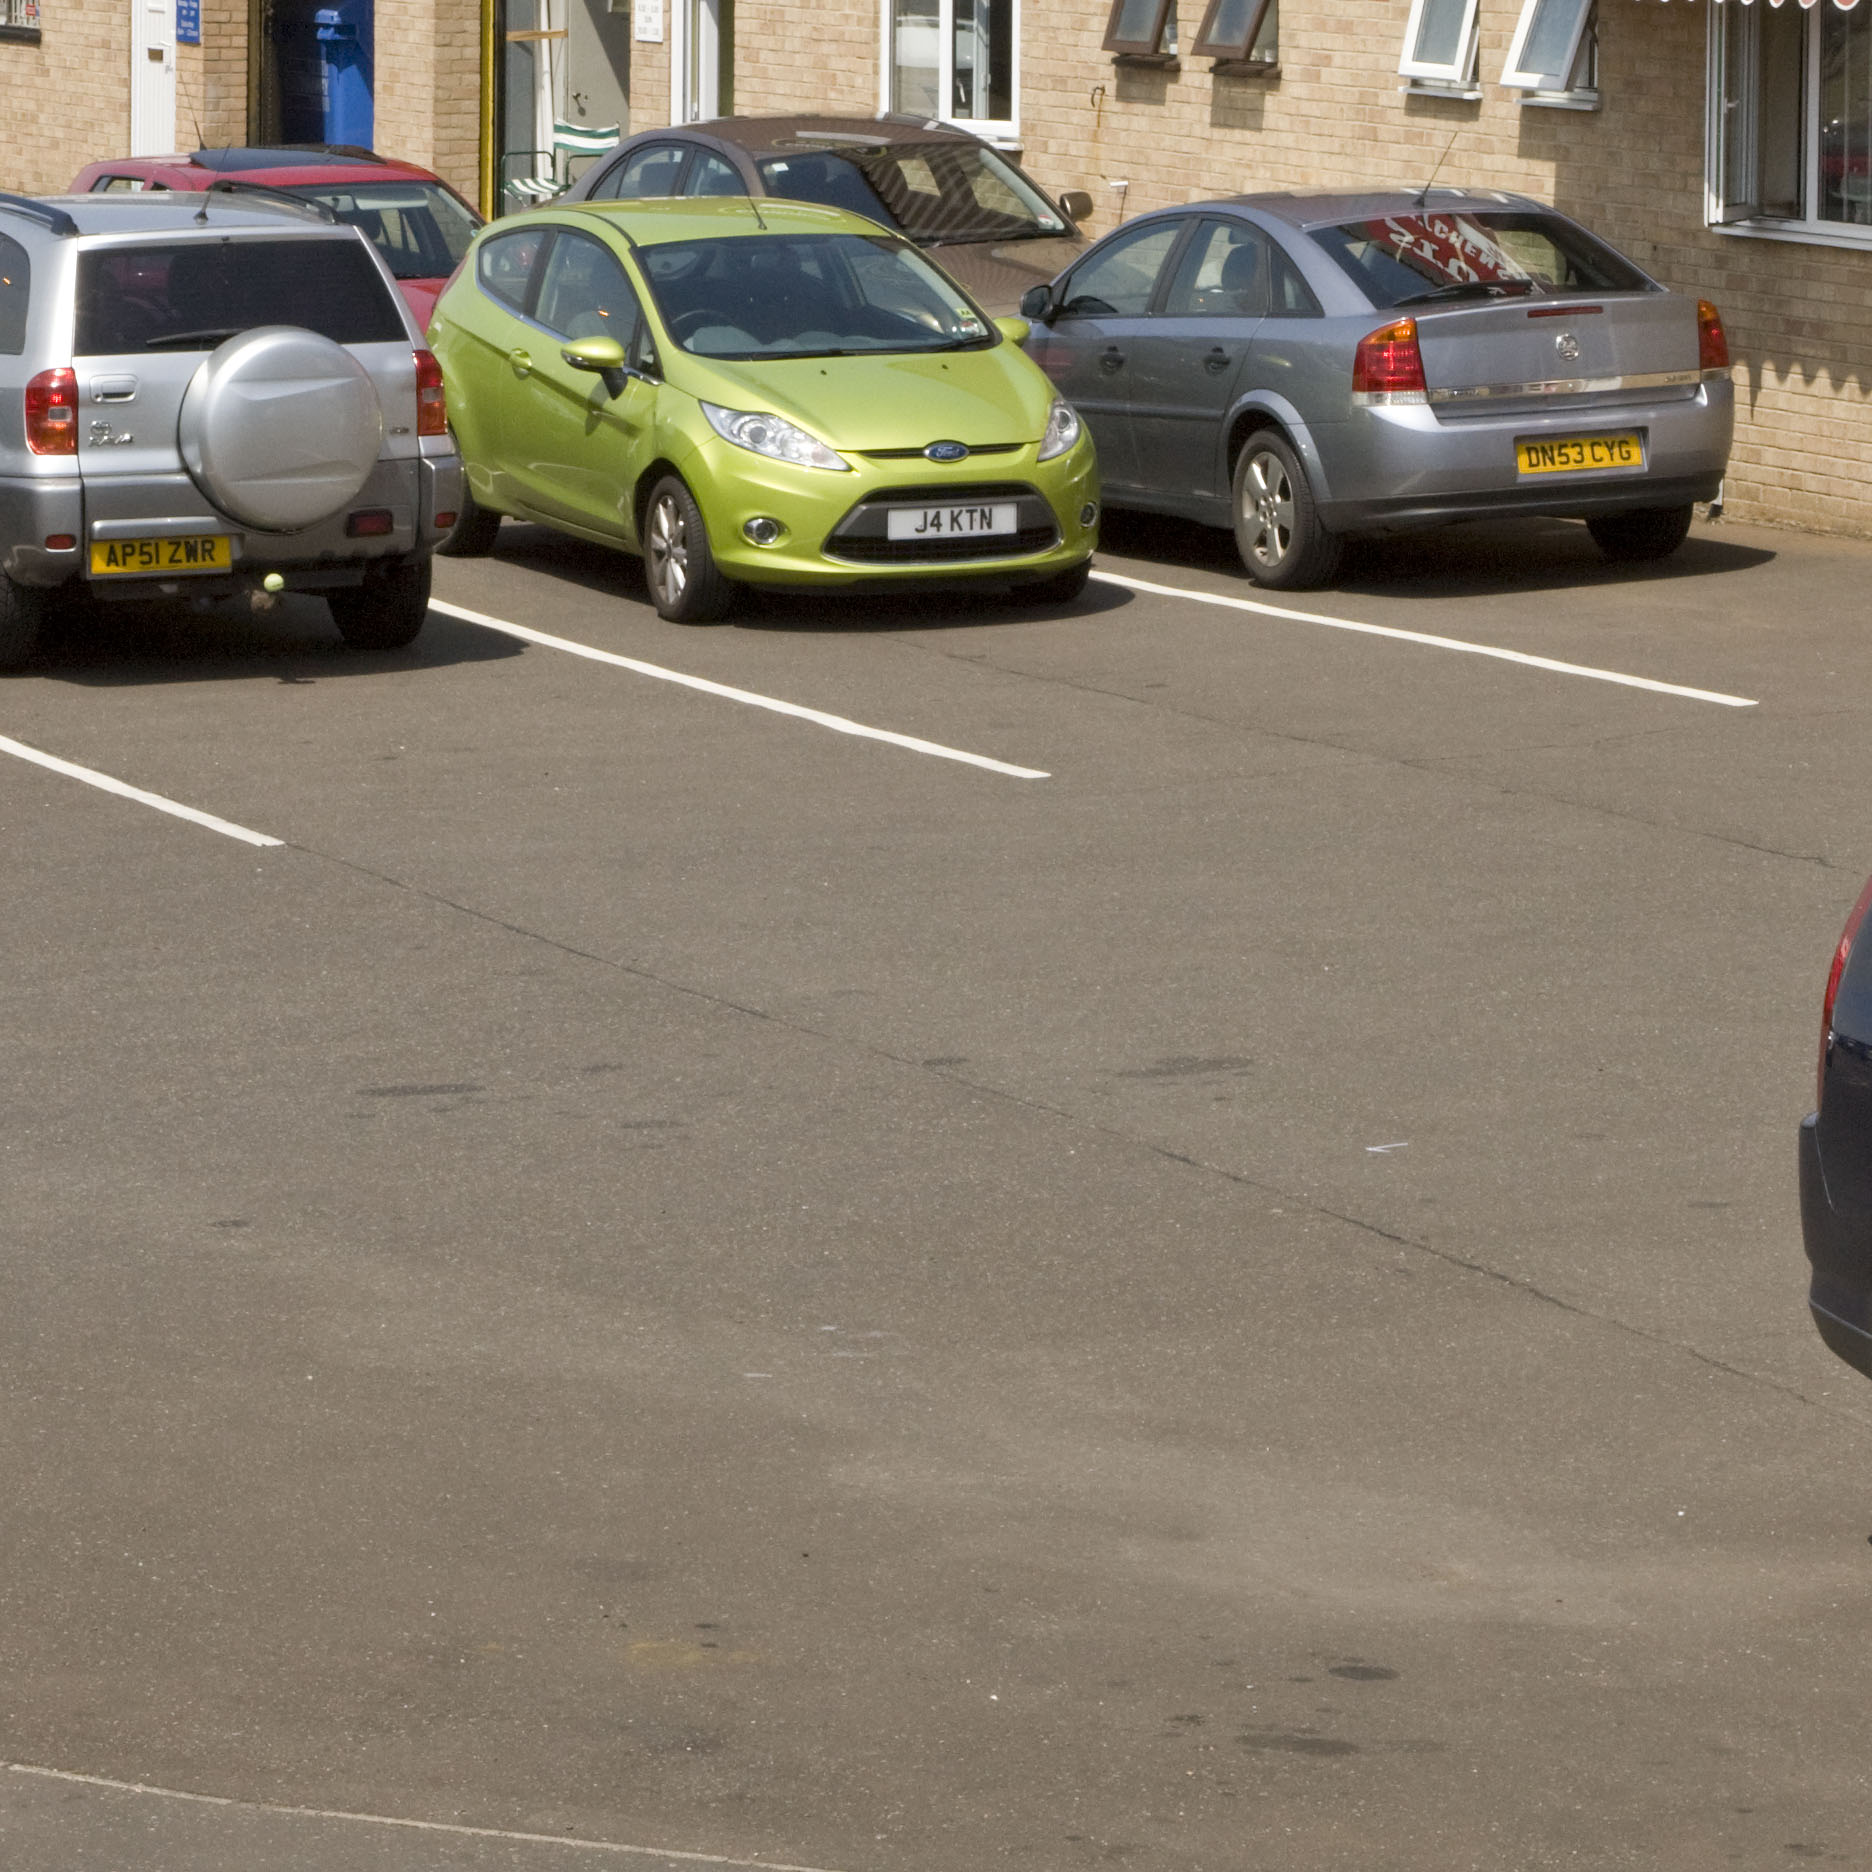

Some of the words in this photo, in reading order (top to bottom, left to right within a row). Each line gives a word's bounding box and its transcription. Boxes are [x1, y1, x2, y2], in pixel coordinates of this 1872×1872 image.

[1527, 442, 1585, 469] DN53
[1591, 439, 1631, 463] CYG
[915, 510, 942, 534] J4
[950, 507, 993, 532] KTN
[106, 541, 160, 567] AP51
[168, 539, 215, 563] ZWR
